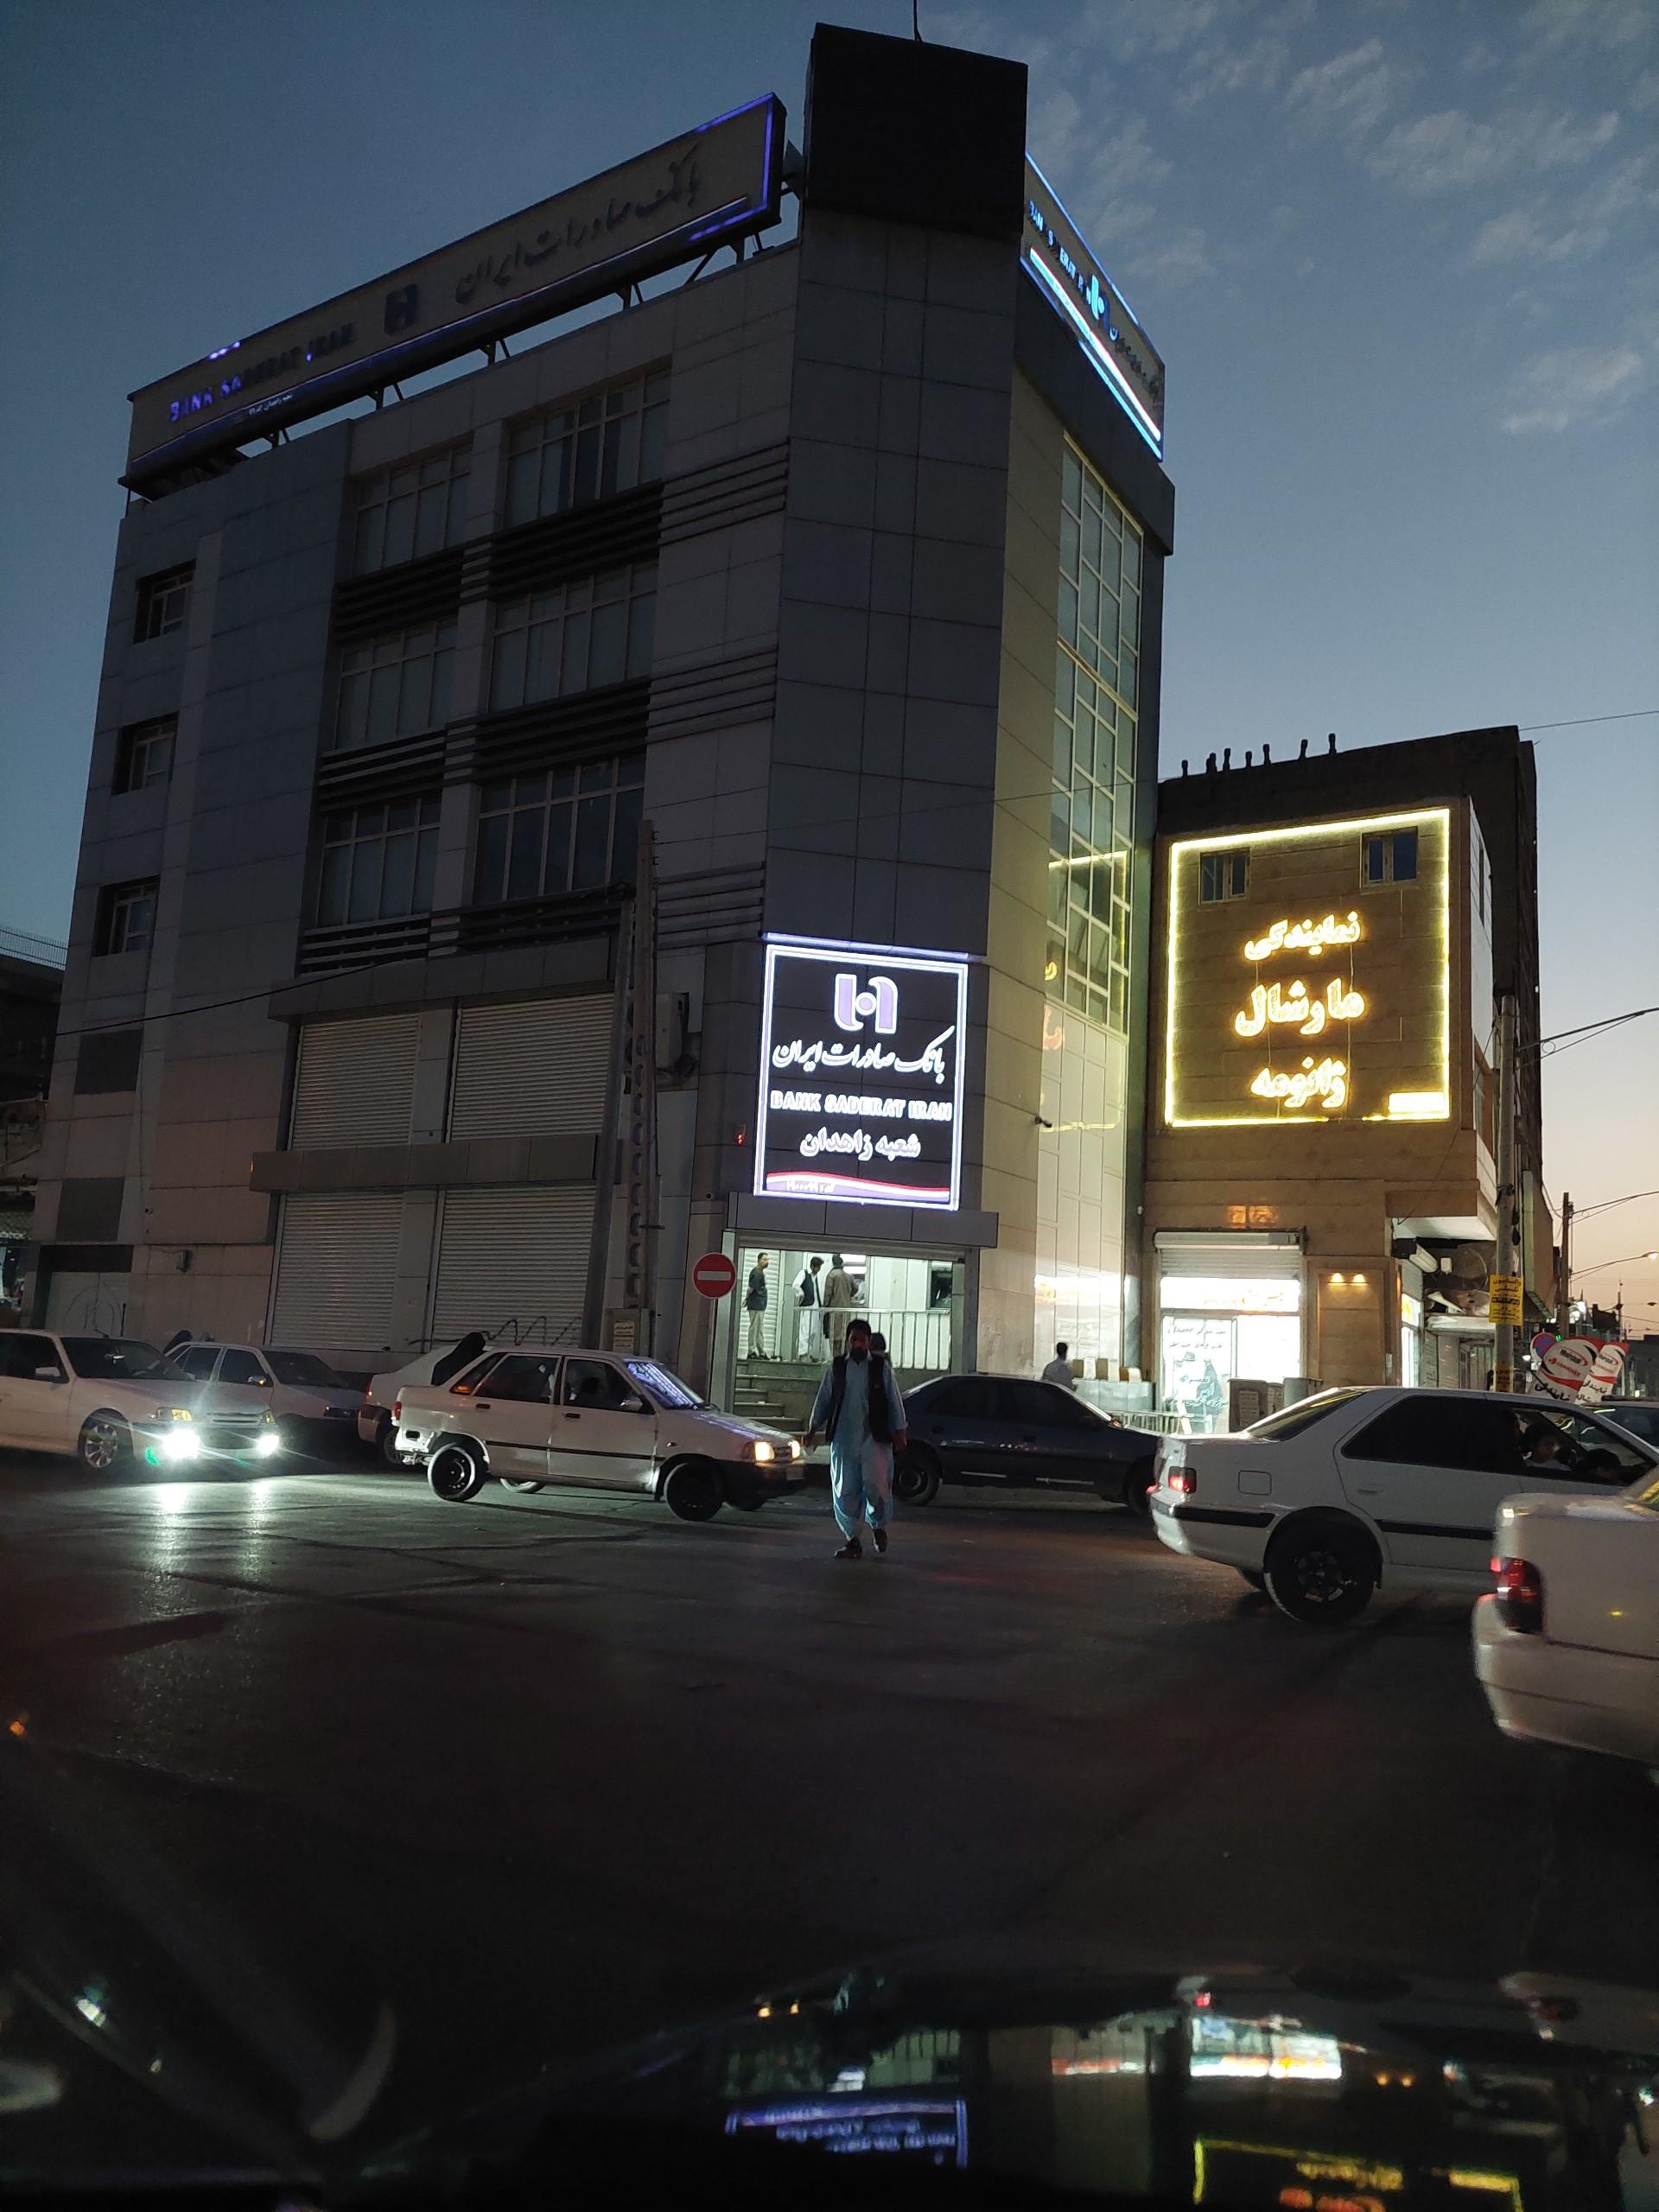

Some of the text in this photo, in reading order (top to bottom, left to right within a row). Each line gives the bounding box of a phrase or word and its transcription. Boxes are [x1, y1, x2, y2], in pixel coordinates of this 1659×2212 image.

[1028, 200, 1048, 236] BAN
[1047, 229, 1077, 279] SERAT
[1245, 912, 1360, 960] نمایندگی
[1235, 978, 1364, 1037] مارشال
[772, 1026, 955, 1084] بانک صادرات ایران
[770, 1090, 953, 1122] BANK SADERAT IRAN
[800, 1127, 921, 1161] شعبه زاهدان
